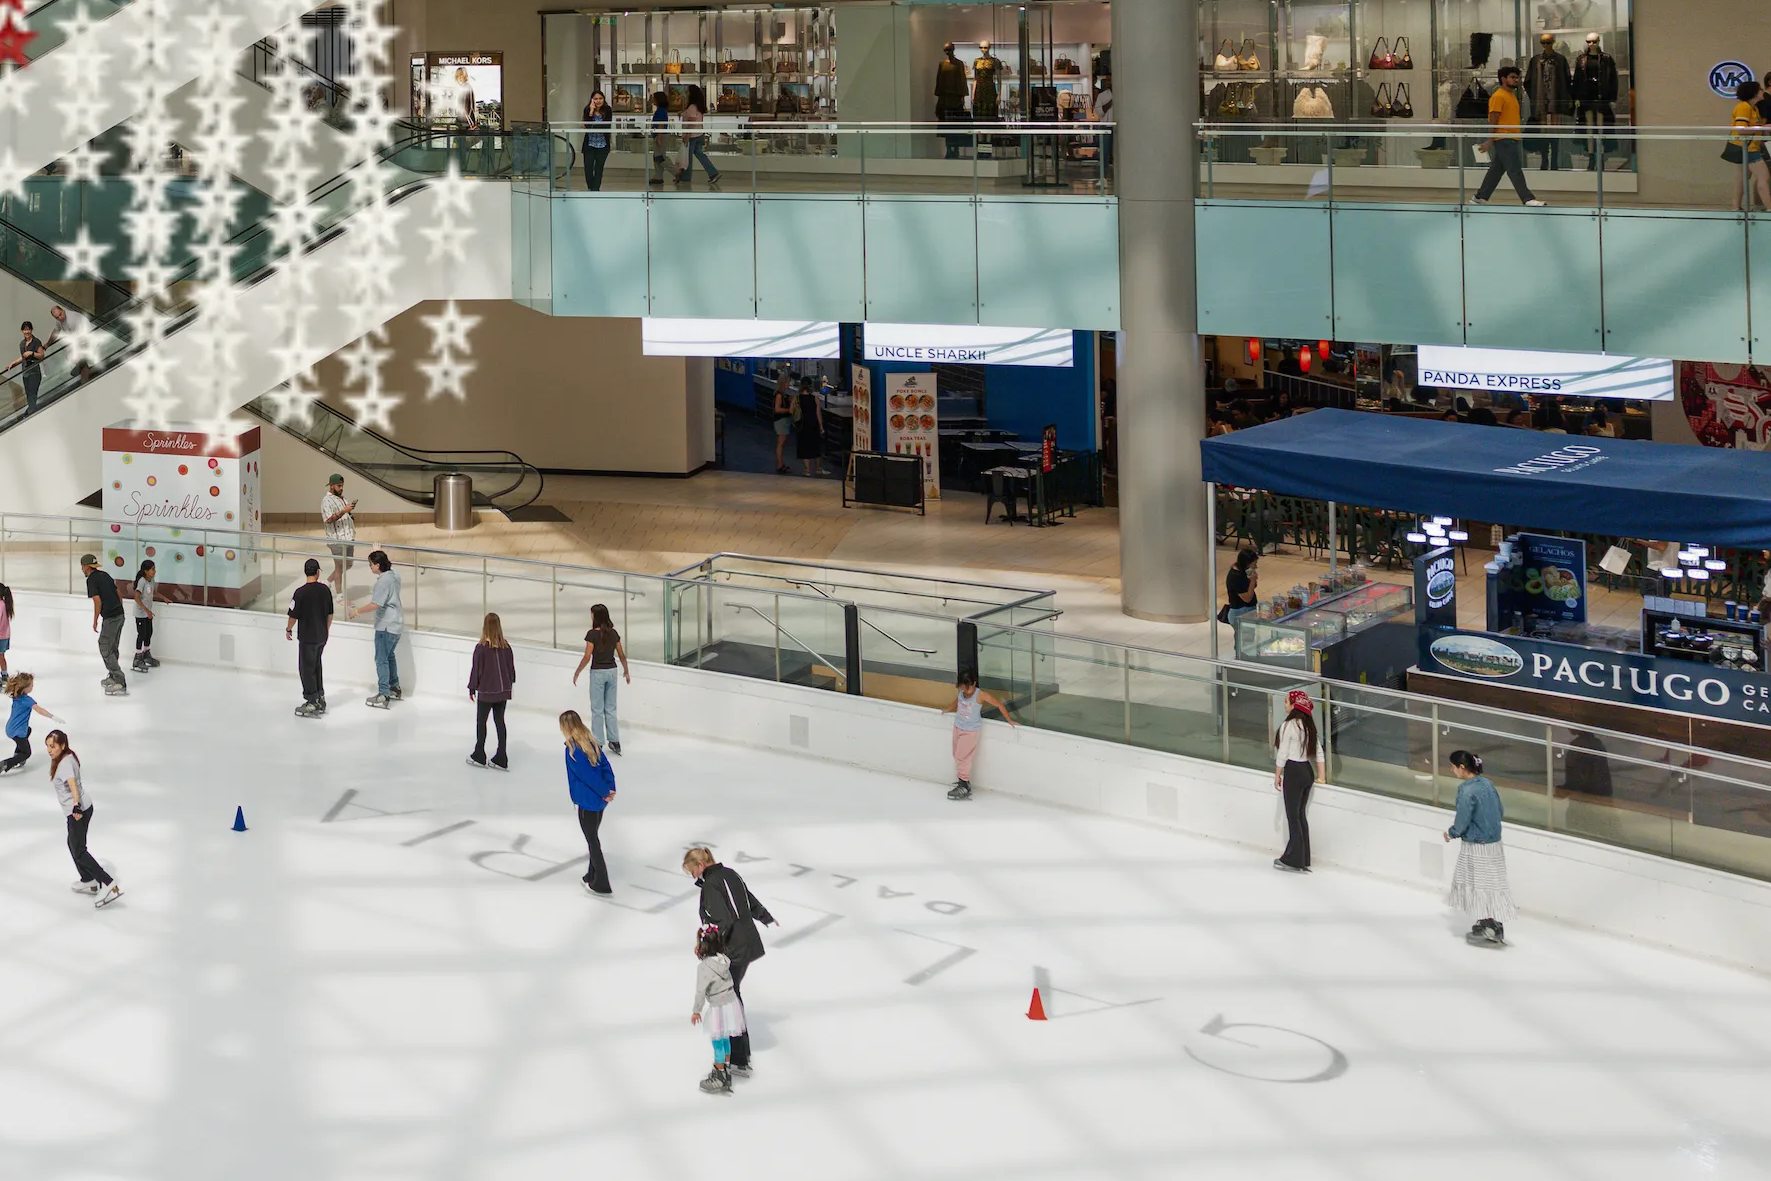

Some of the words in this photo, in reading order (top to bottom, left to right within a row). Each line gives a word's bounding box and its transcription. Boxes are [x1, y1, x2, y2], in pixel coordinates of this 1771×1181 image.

[875, 347, 923, 358] UNCLE
[928, 348, 986, 360] SHARKII
[1424, 371, 1481, 386] PANDA
[1486, 375, 1562, 390] EXPRESS
[143, 432, 198, 451] Sprinkles
[124, 490, 218, 522] Sprinkles
[1529, 546, 1575, 557] GELACHOS
[1531, 652, 1730, 705] PACIUGO
